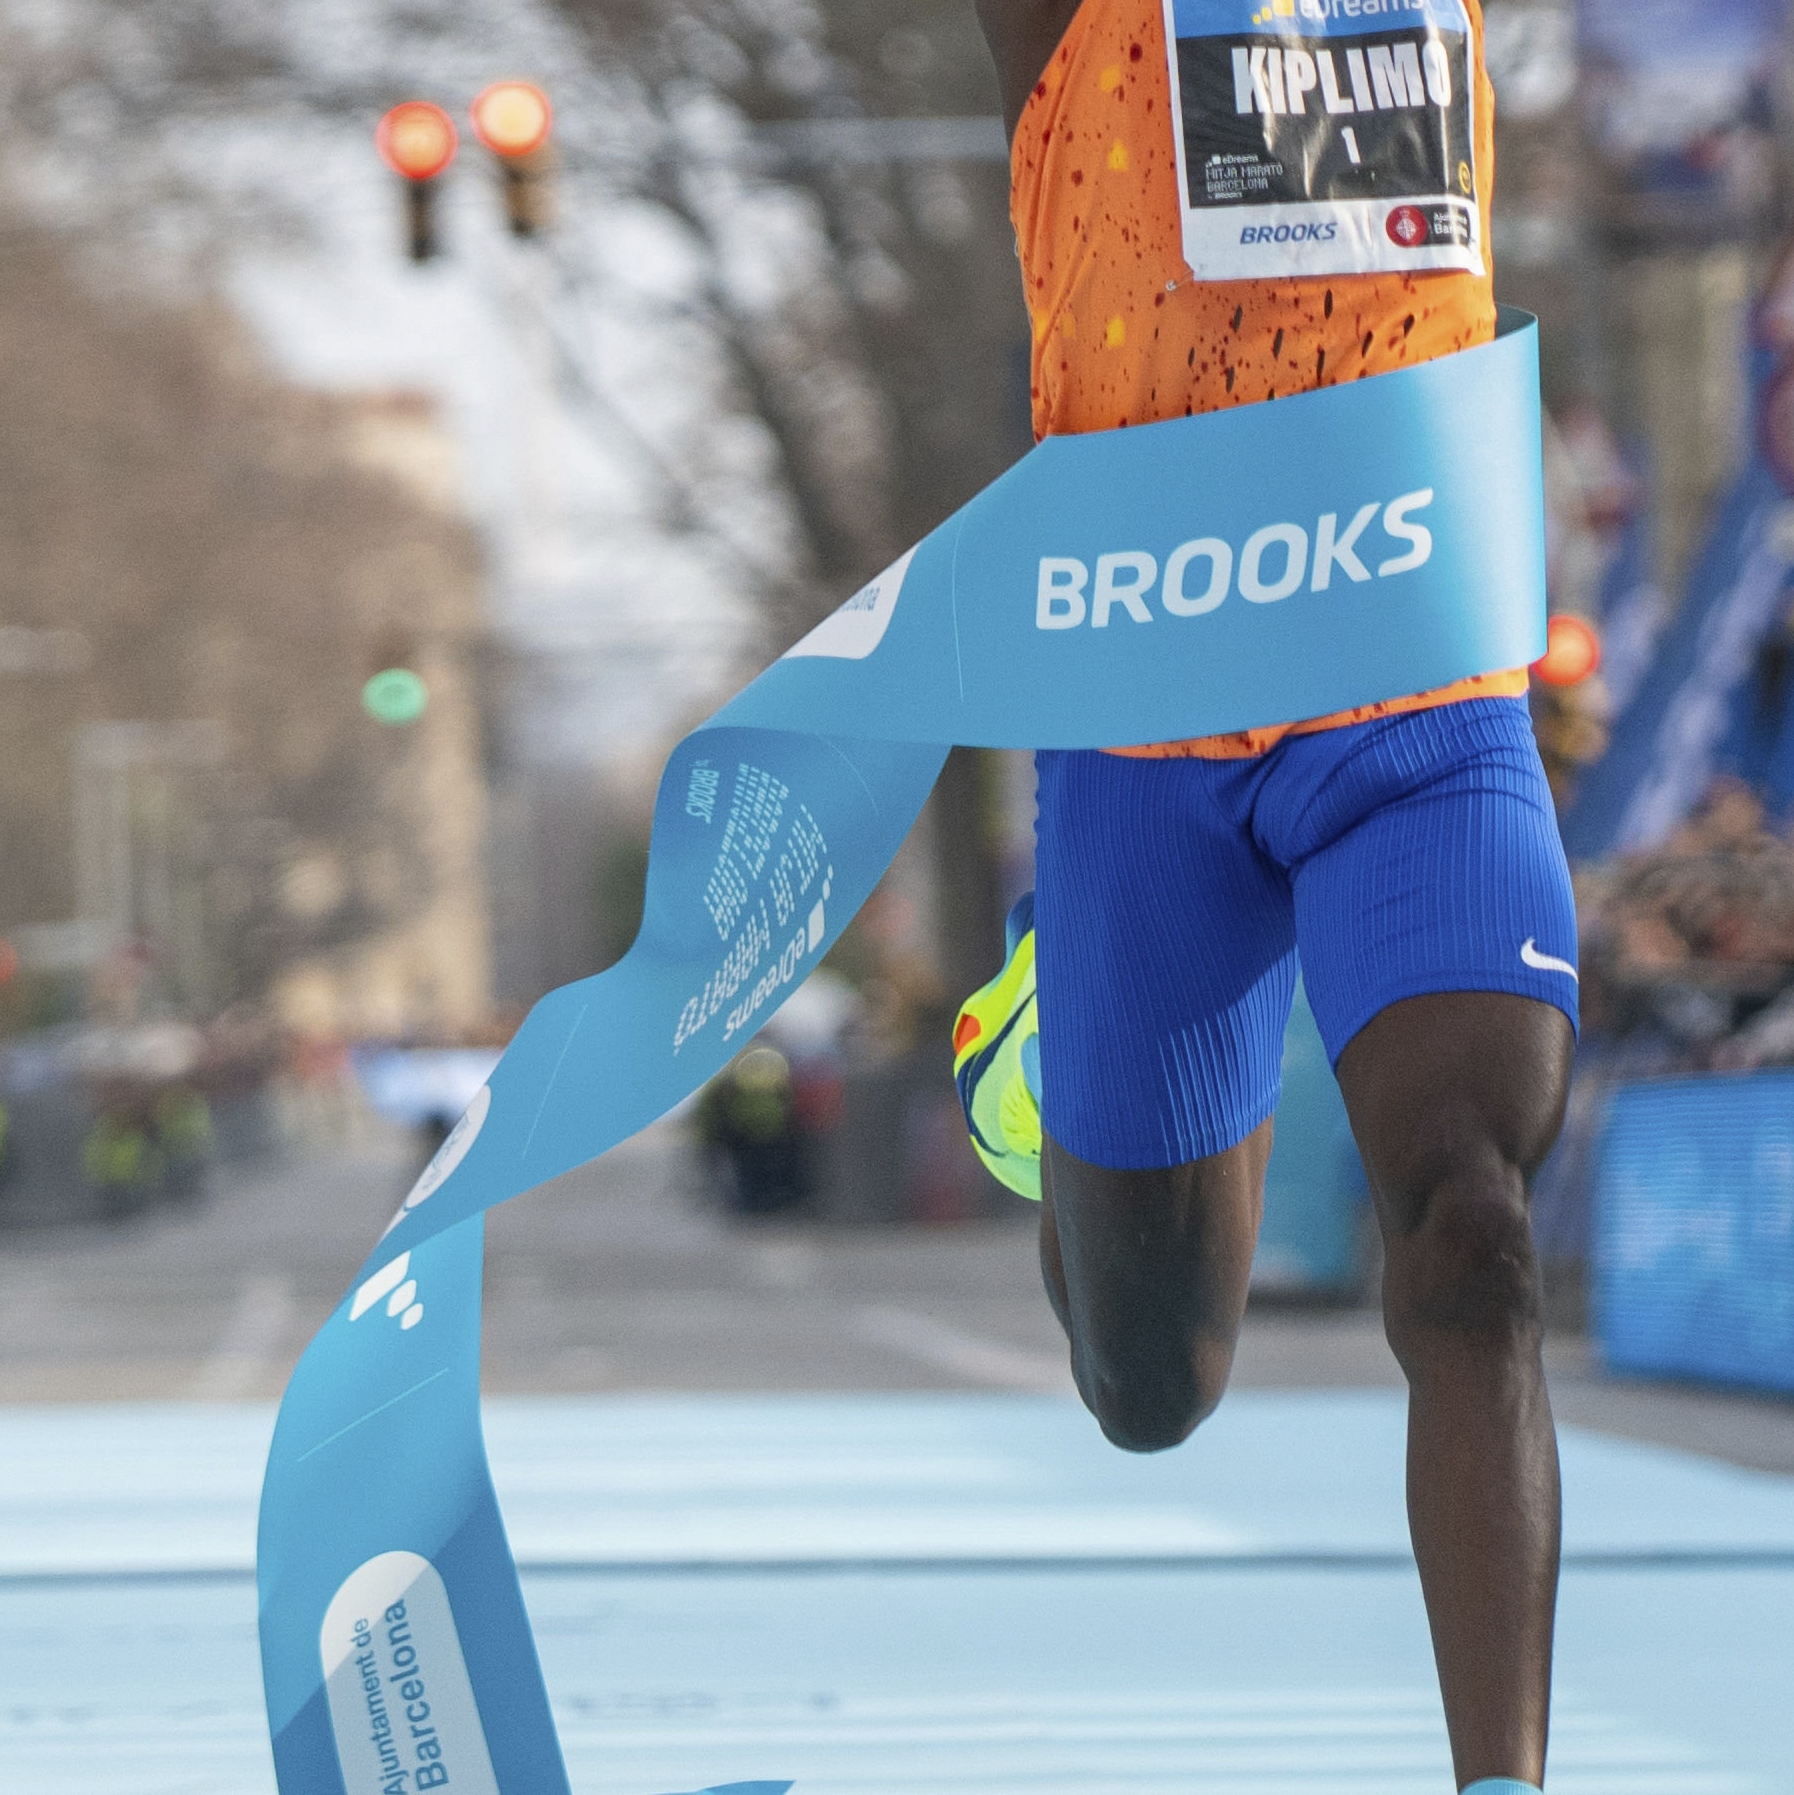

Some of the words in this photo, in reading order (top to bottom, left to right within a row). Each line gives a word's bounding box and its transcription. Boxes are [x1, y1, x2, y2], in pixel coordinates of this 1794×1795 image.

[1231, 37, 1452, 114] KIPLIMO
[1341, 126, 1360, 164] 1
[1207, 178, 1268, 193] BARCELONA
[1240, 222, 1338, 246] BROOKS
[1034, 487, 1434, 631] BROOKS
[686, 769, 719, 824] BROOKS
[722, 927, 806, 1042] eDreams
[350, 1617, 372, 1648] de
[355, 1649, 409, 1795] Ajuntament
[384, 1598, 450, 1792] Barcelona
